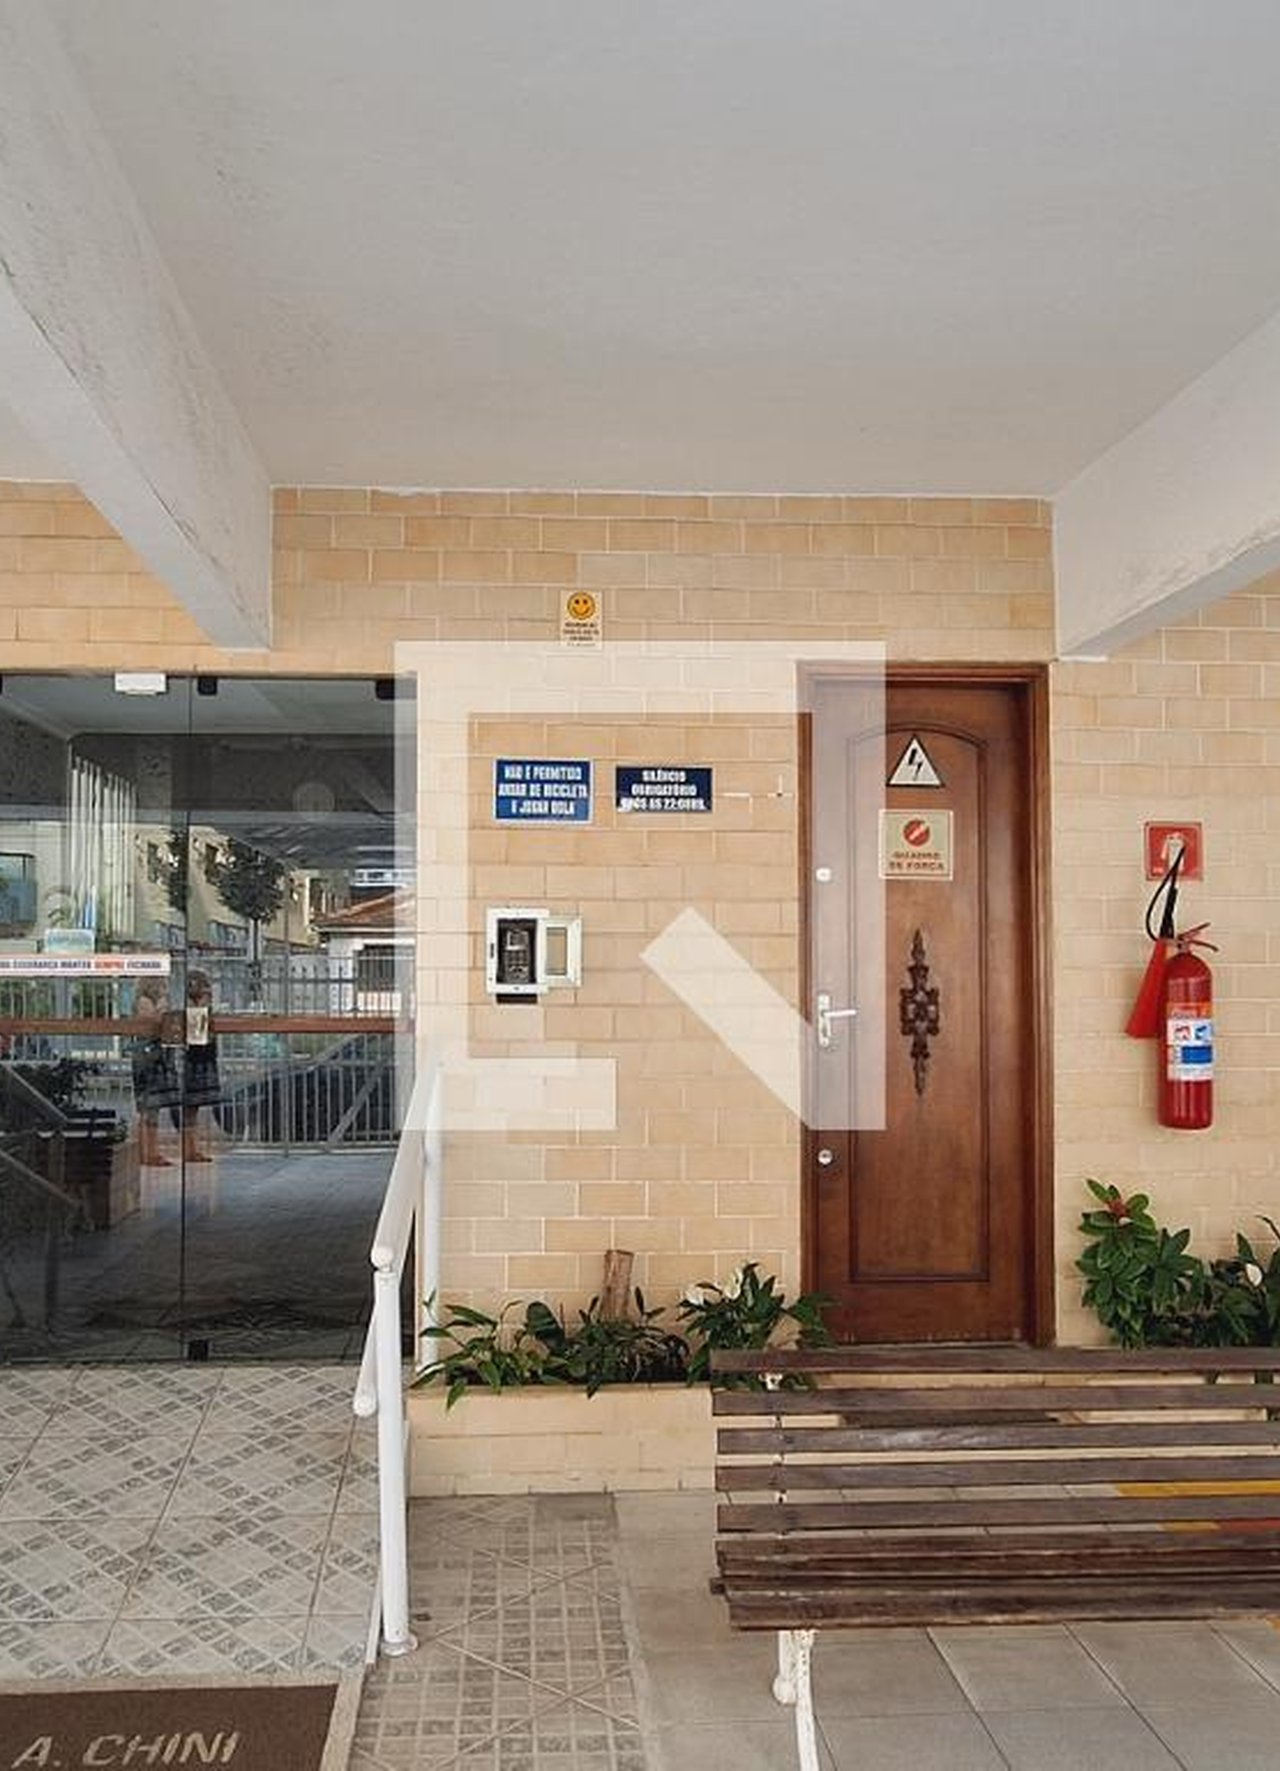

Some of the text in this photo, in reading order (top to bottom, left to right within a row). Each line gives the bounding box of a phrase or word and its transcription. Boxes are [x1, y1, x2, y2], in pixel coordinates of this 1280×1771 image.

[529, 783, 542, 797] DE
[543, 783, 588, 798] BICICLETA
[11, 1735, 61, 1768] A.
[81, 1731, 241, 1766] CHINI
